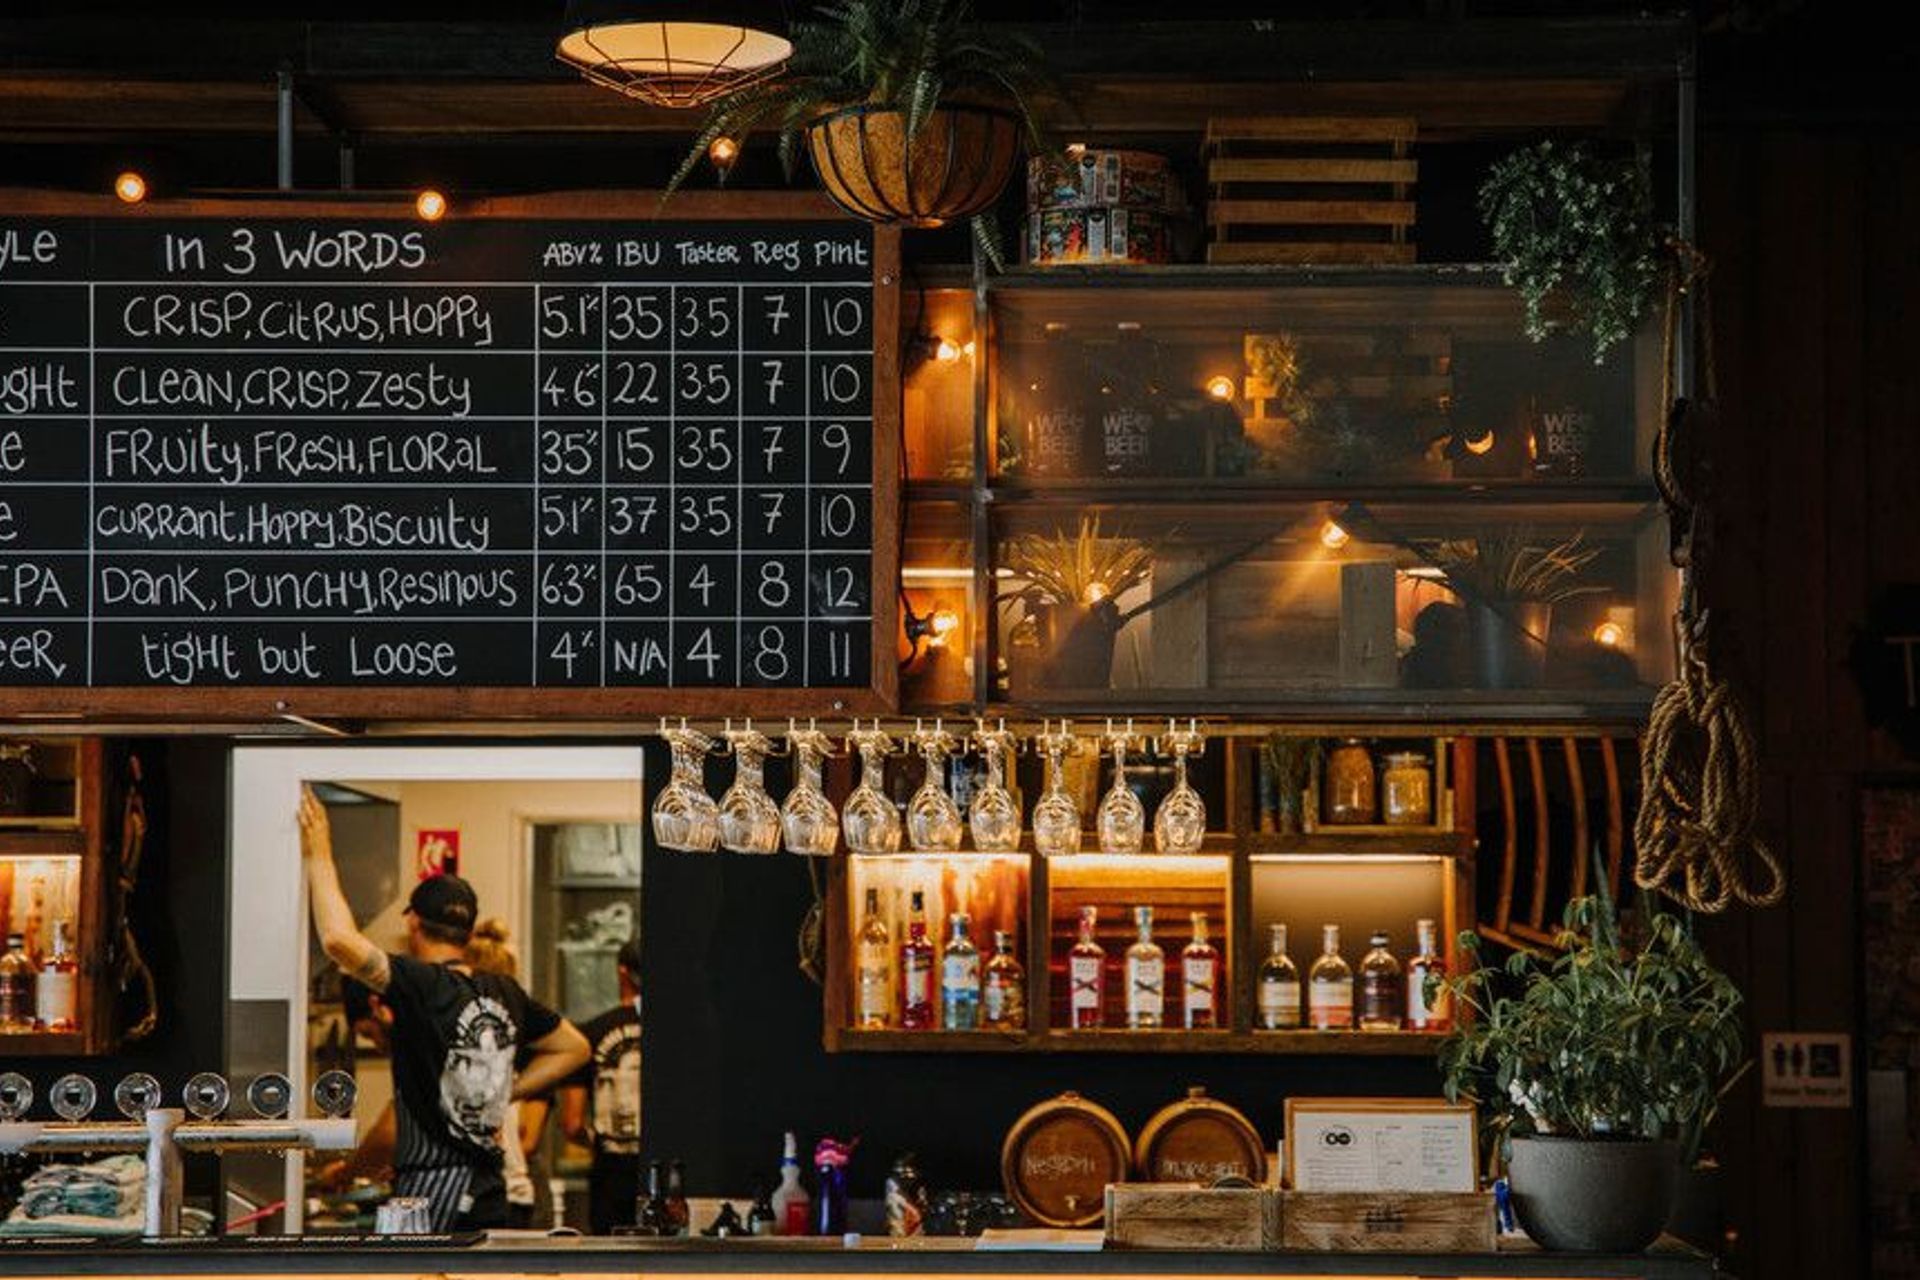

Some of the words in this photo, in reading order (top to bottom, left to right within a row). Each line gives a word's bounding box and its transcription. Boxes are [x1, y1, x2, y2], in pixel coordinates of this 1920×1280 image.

[223, 228, 256, 274] 3
[616, 240, 660, 266] IBU
[752, 240, 800, 271] Reg
[814, 239, 868, 266] Pint
[608, 295, 663, 340] 35
[763, 295, 789, 334] 7
[824, 298, 862, 336] 10
[613, 361, 659, 404] 22
[762, 360, 784, 404] 7
[822, 363, 860, 403] 10
[617, 426, 654, 471] 15
[763, 426, 783, 473] 7
[823, 424, 851, 475] 9
[609, 496, 657, 536] 37
[759, 492, 785, 534] 7
[821, 494, 856, 537] 10
[614, 564, 663, 605] 65
[689, 564, 716, 607] 4
[758, 560, 790, 607] 8
[825, 567, 859, 607] 12
[257, 631, 321, 679] but
[613, 638, 667, 676] N/A
[685, 627, 721, 678] 4
[754, 625, 788, 680] 8
[829, 632, 851, 677] 11
